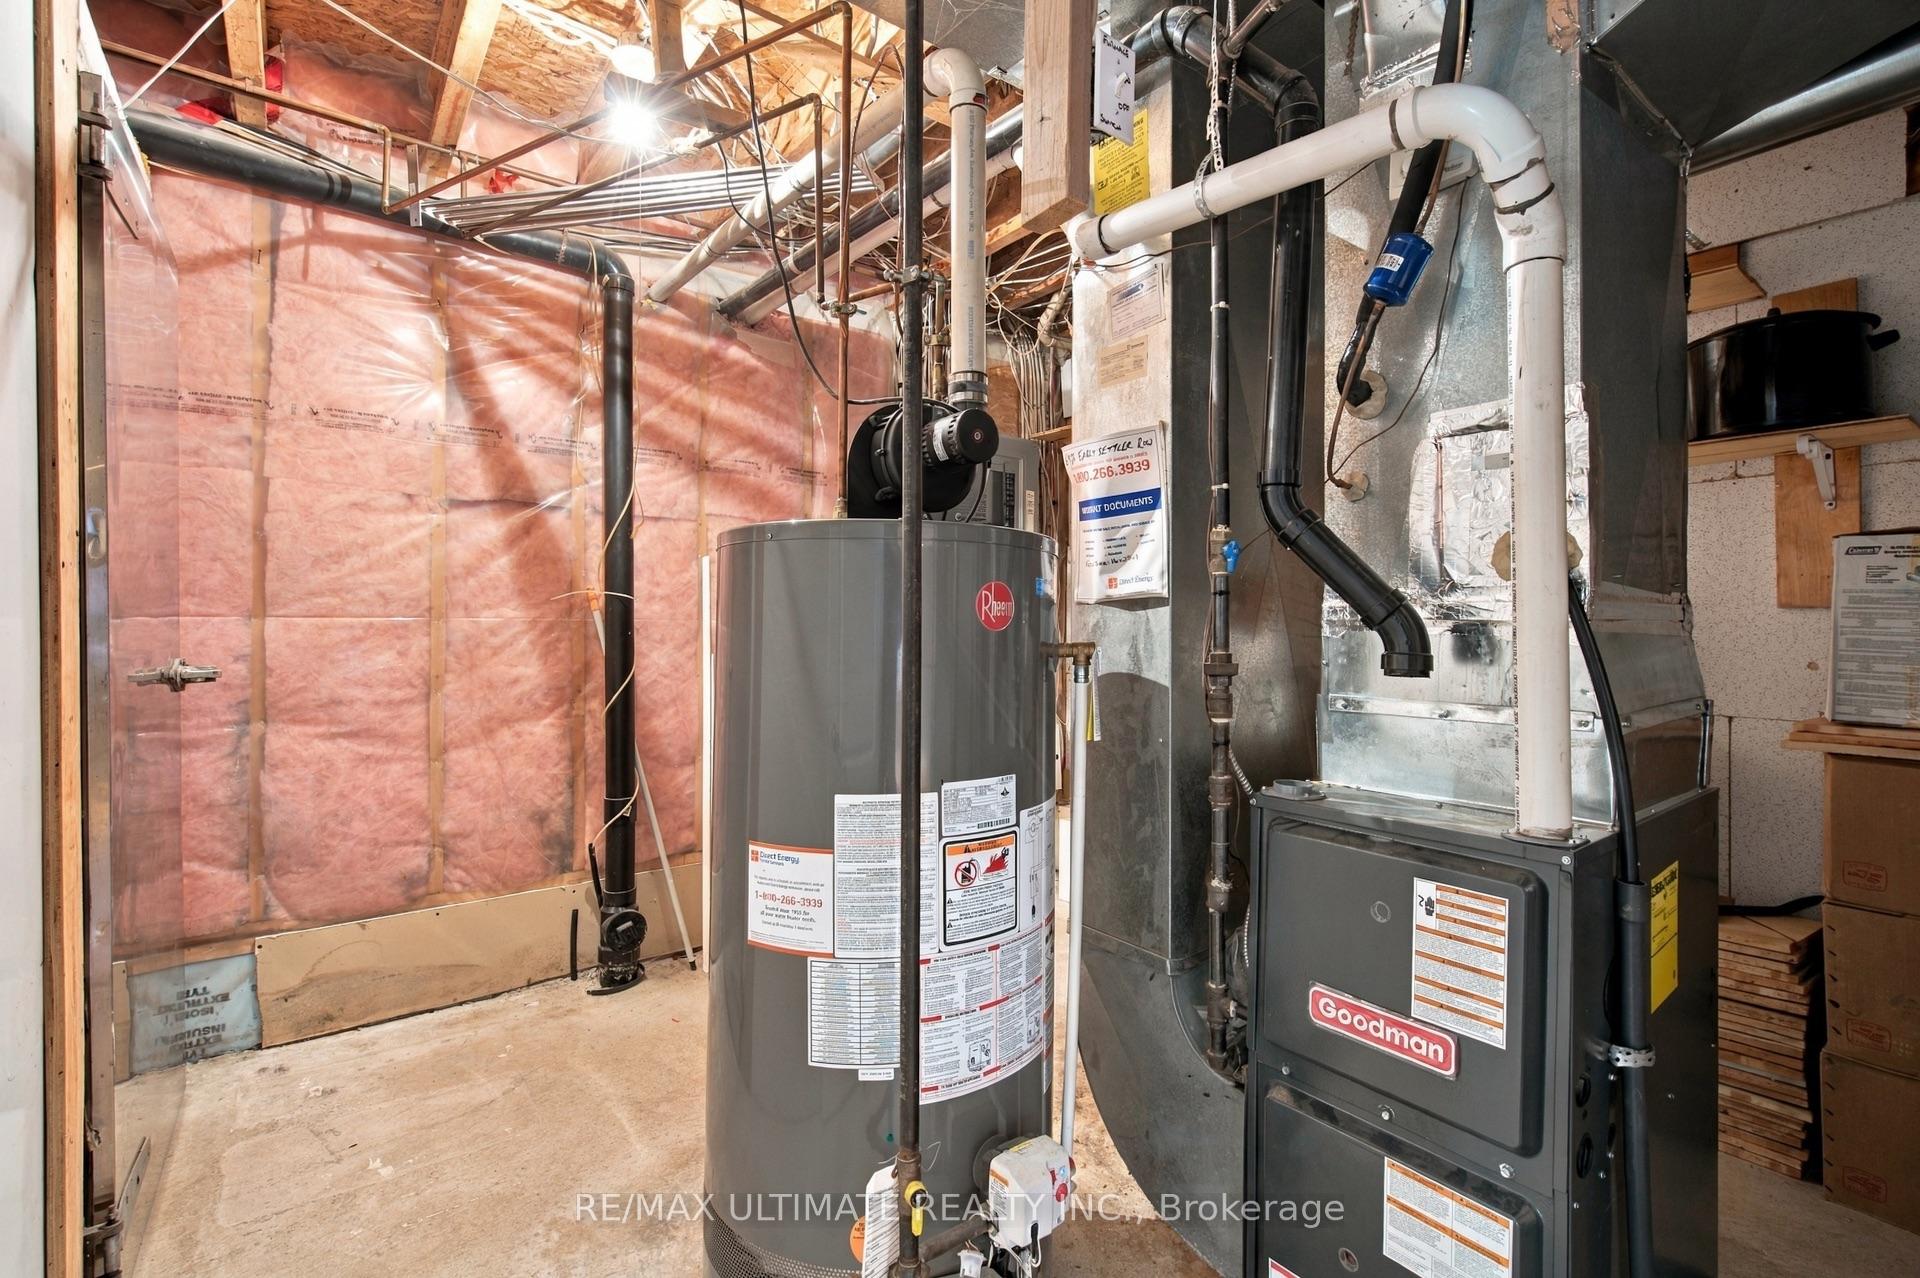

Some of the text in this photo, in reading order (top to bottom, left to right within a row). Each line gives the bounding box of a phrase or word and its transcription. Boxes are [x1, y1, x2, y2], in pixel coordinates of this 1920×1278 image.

[1104, 496, 1154, 512] DOCUMENTS
[981, 582, 1013, 623] Rheem
[760, 851, 800, 865] Direct Energy
[1318, 997, 1444, 1063] Goodman
